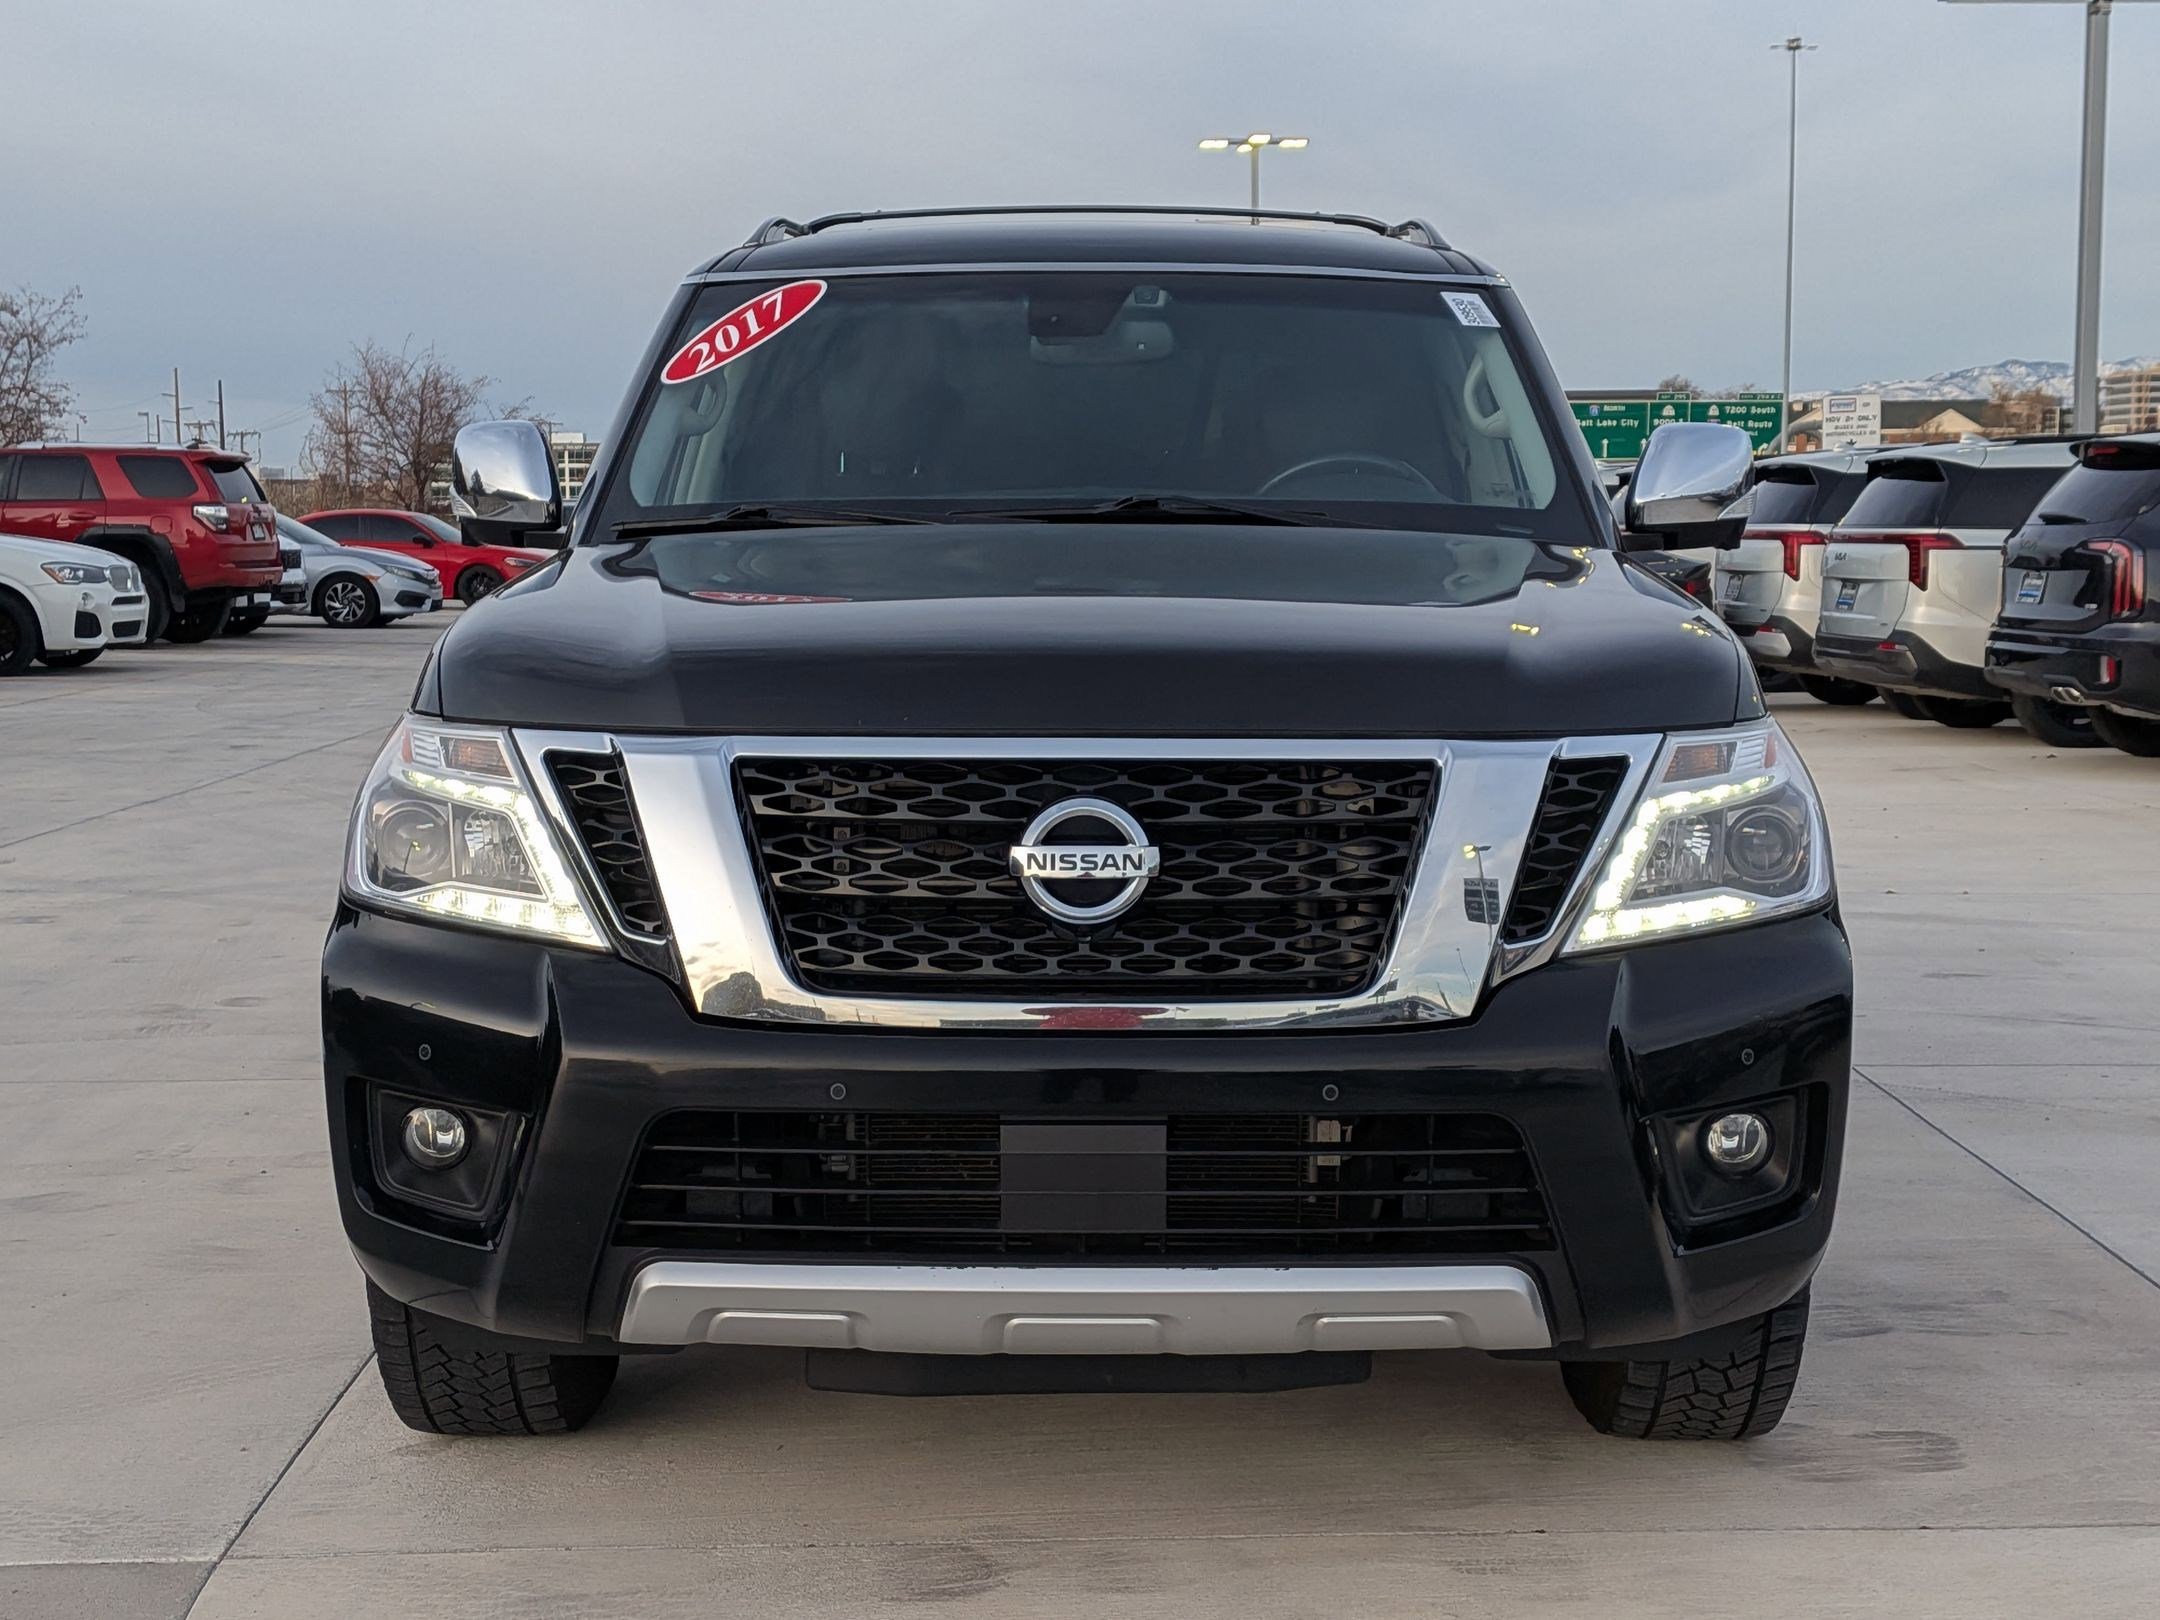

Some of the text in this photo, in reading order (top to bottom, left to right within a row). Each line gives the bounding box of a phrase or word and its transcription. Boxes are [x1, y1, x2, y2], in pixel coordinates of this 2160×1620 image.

[688, 290, 784, 374] 2017
[1621, 419, 1640, 428] City
[1748, 420, 1772, 428] Route
[1026, 853, 1143, 871] NISSAN
